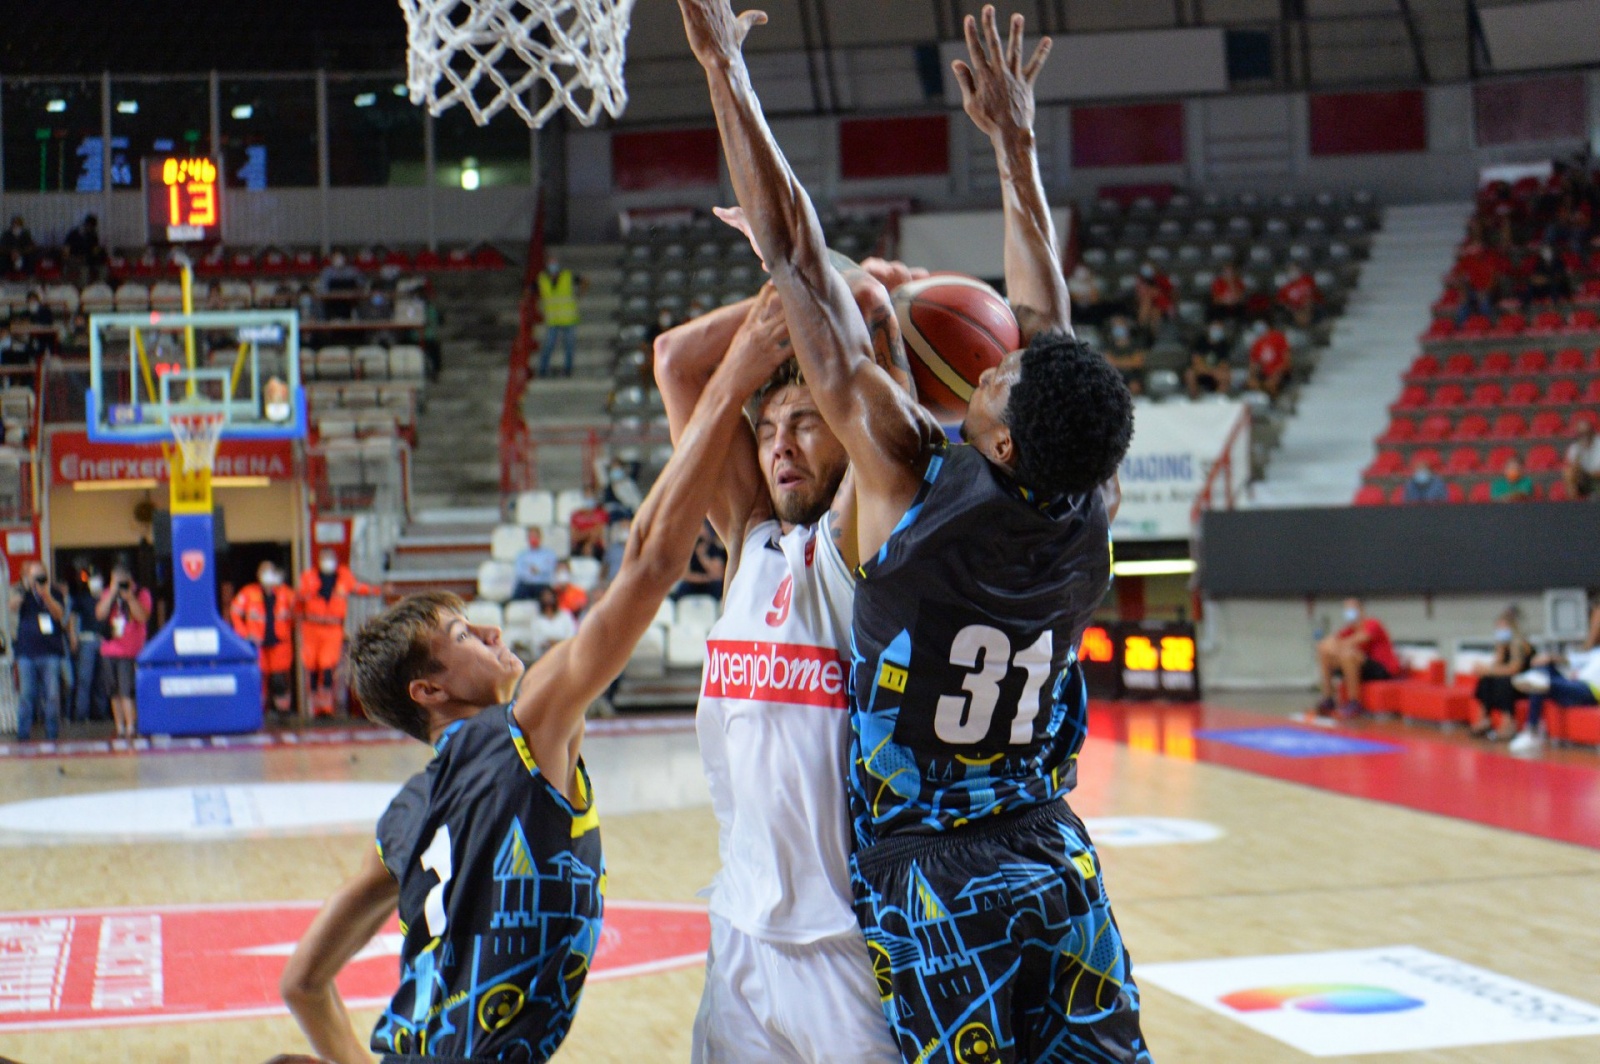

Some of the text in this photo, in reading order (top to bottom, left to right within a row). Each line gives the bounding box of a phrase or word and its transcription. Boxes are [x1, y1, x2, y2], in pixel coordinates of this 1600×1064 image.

[169, 183, 216, 227] 13
[59, 454, 177, 480] Enerxen
[765, 573, 793, 627] 9
[710, 643, 849, 699] openjobme
[934, 624, 1053, 745] 31
